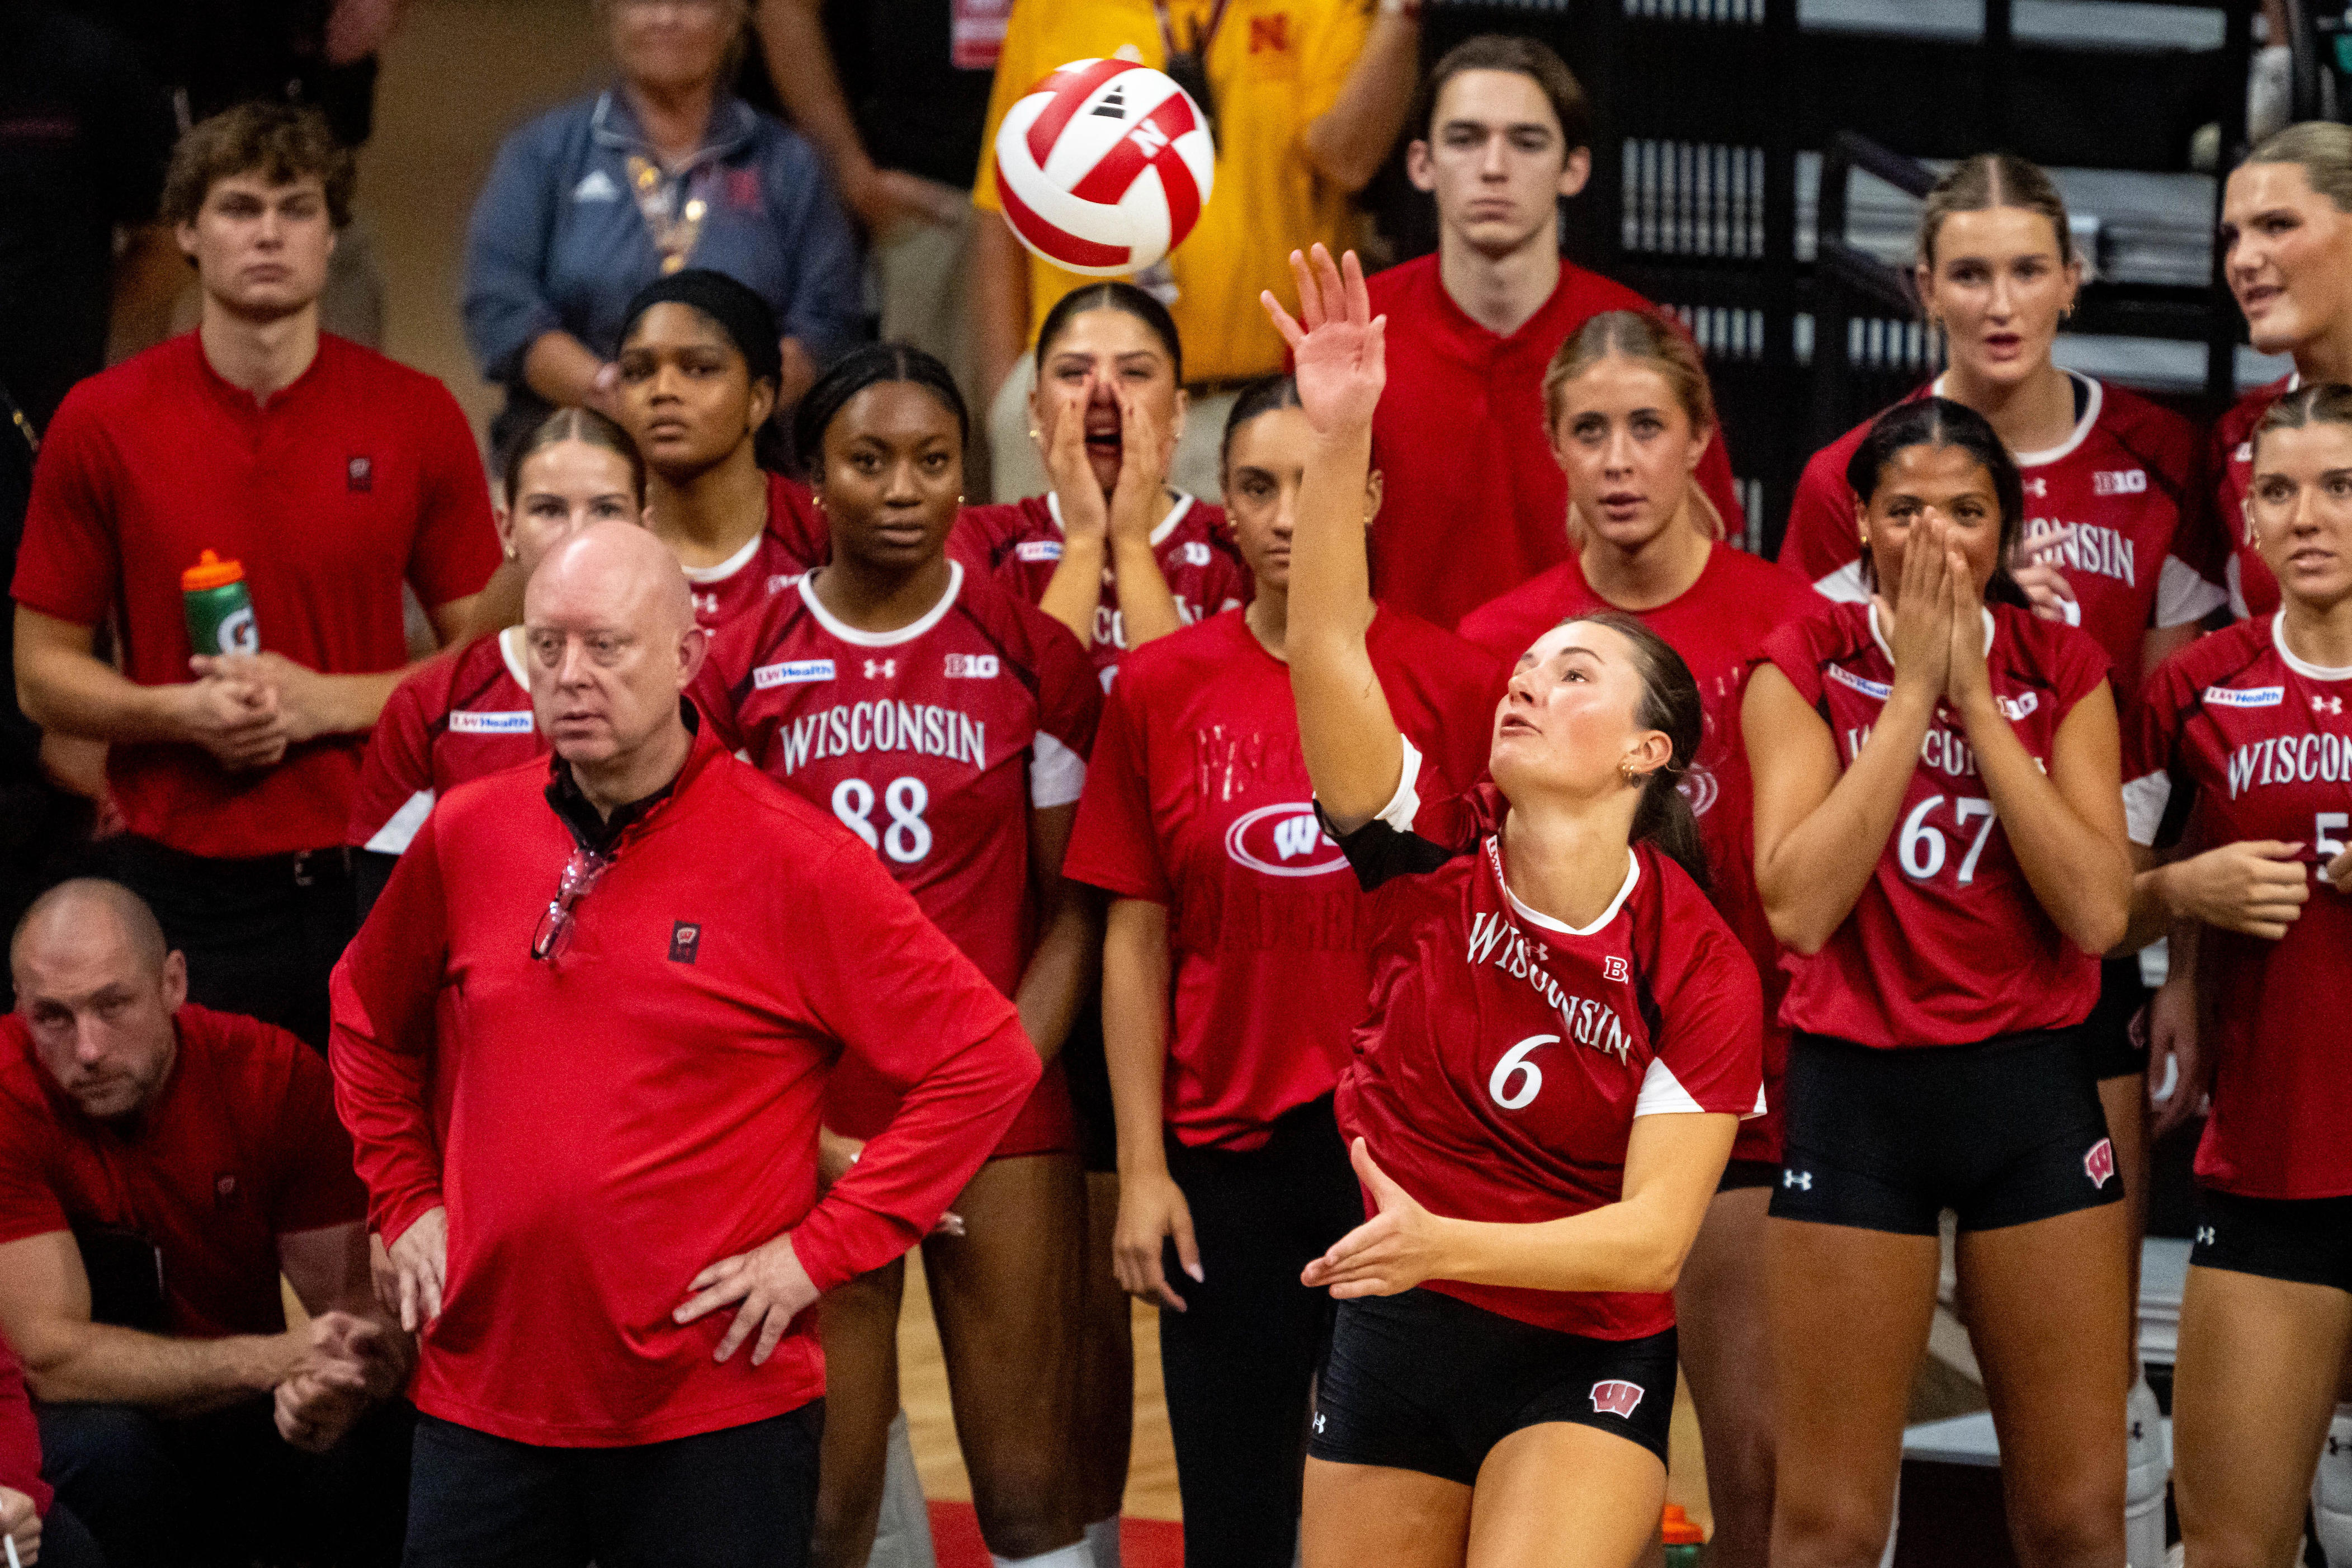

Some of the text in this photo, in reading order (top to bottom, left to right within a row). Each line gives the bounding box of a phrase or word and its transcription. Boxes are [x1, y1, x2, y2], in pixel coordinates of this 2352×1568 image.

[1130, 119, 1168, 157] N
[218, 607, 258, 655] G
[780, 698, 986, 776] WISCONSIN
[832, 776, 933, 863] 88
[1898, 795, 1996, 882] 67
[1489, 1034, 1560, 1109] 6
[1589, 1380, 1645, 1419] W
